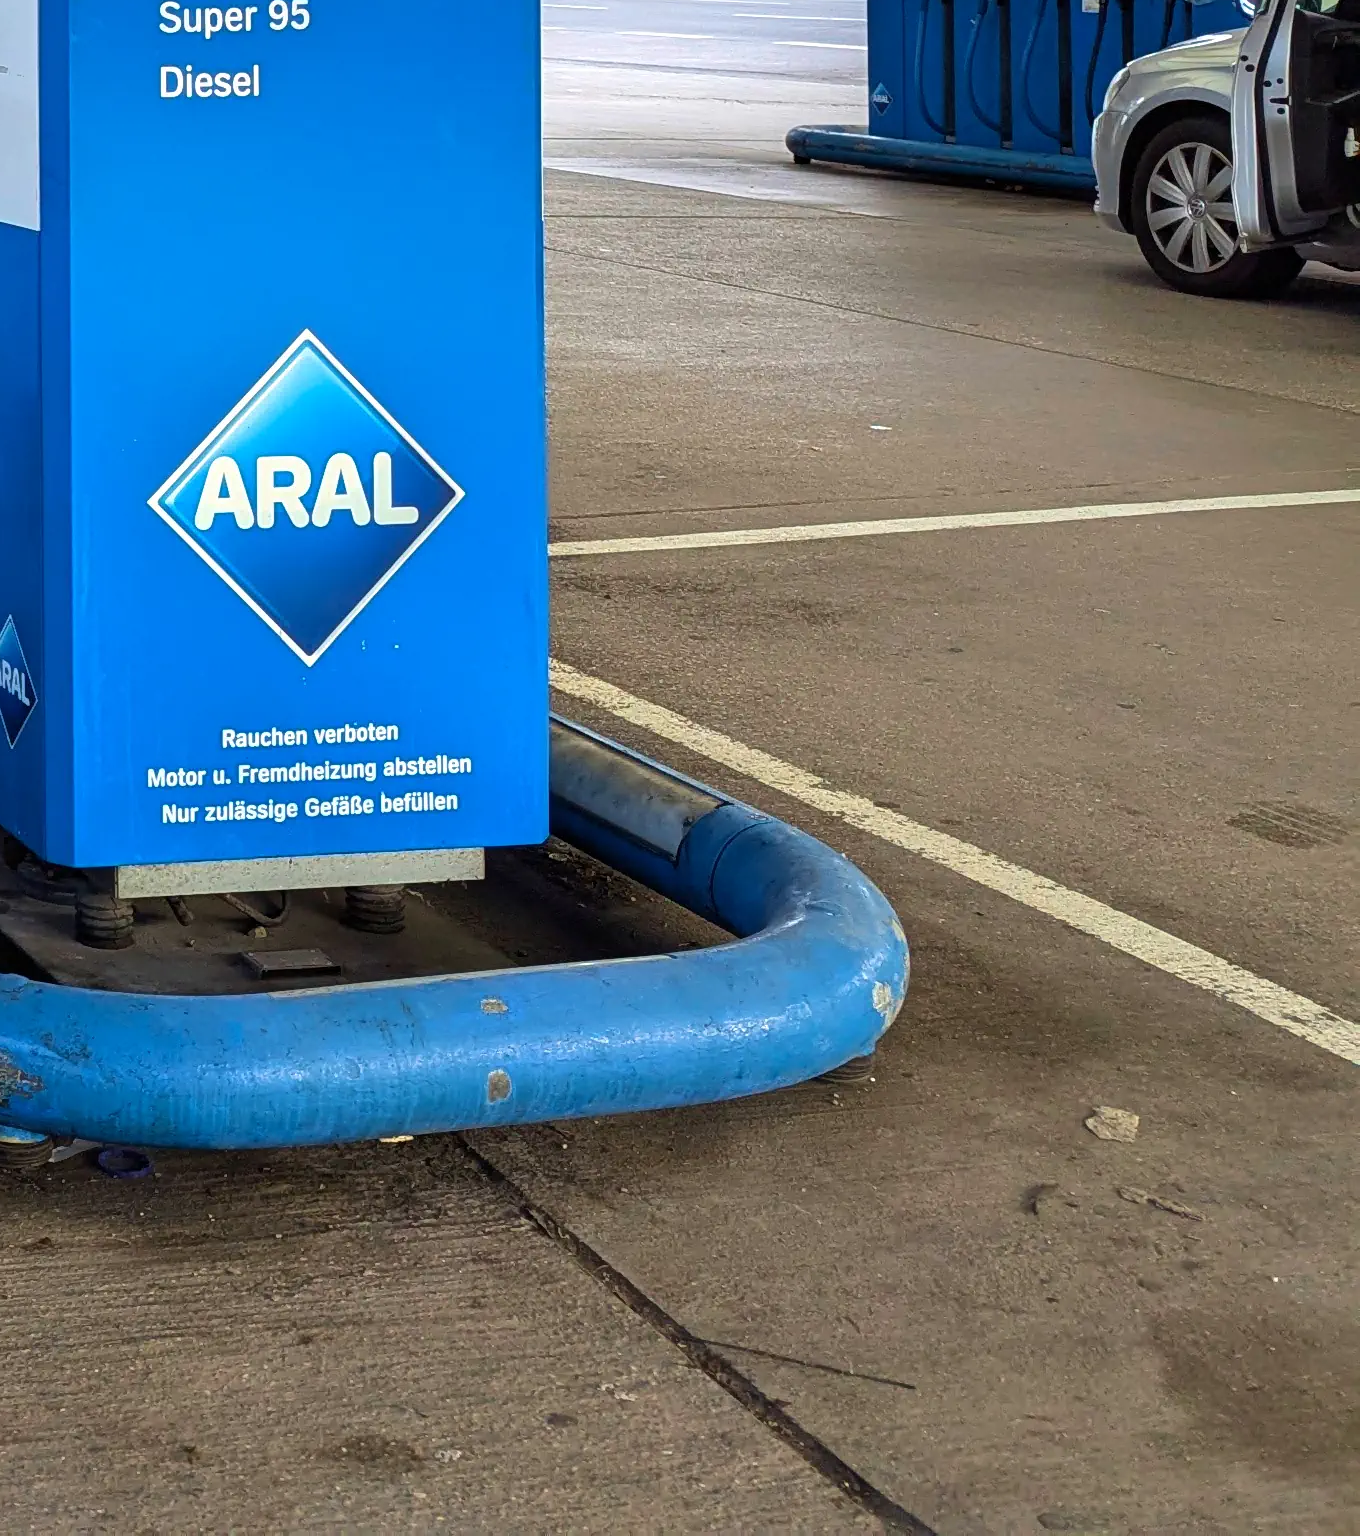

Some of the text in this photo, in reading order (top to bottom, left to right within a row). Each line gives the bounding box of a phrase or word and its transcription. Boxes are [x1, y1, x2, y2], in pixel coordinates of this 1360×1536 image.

[158, 0, 311, 39] Super 95
[160, 64, 261, 99] Diesel
[194, 451, 419, 531] ARAL
[221, 723, 399, 749] Rauchen verboten
[147, 754, 472, 788] Motor u. Fremdheizung abstellen
[162, 790, 459, 824] Nur zulässige Gefäße befüllen
